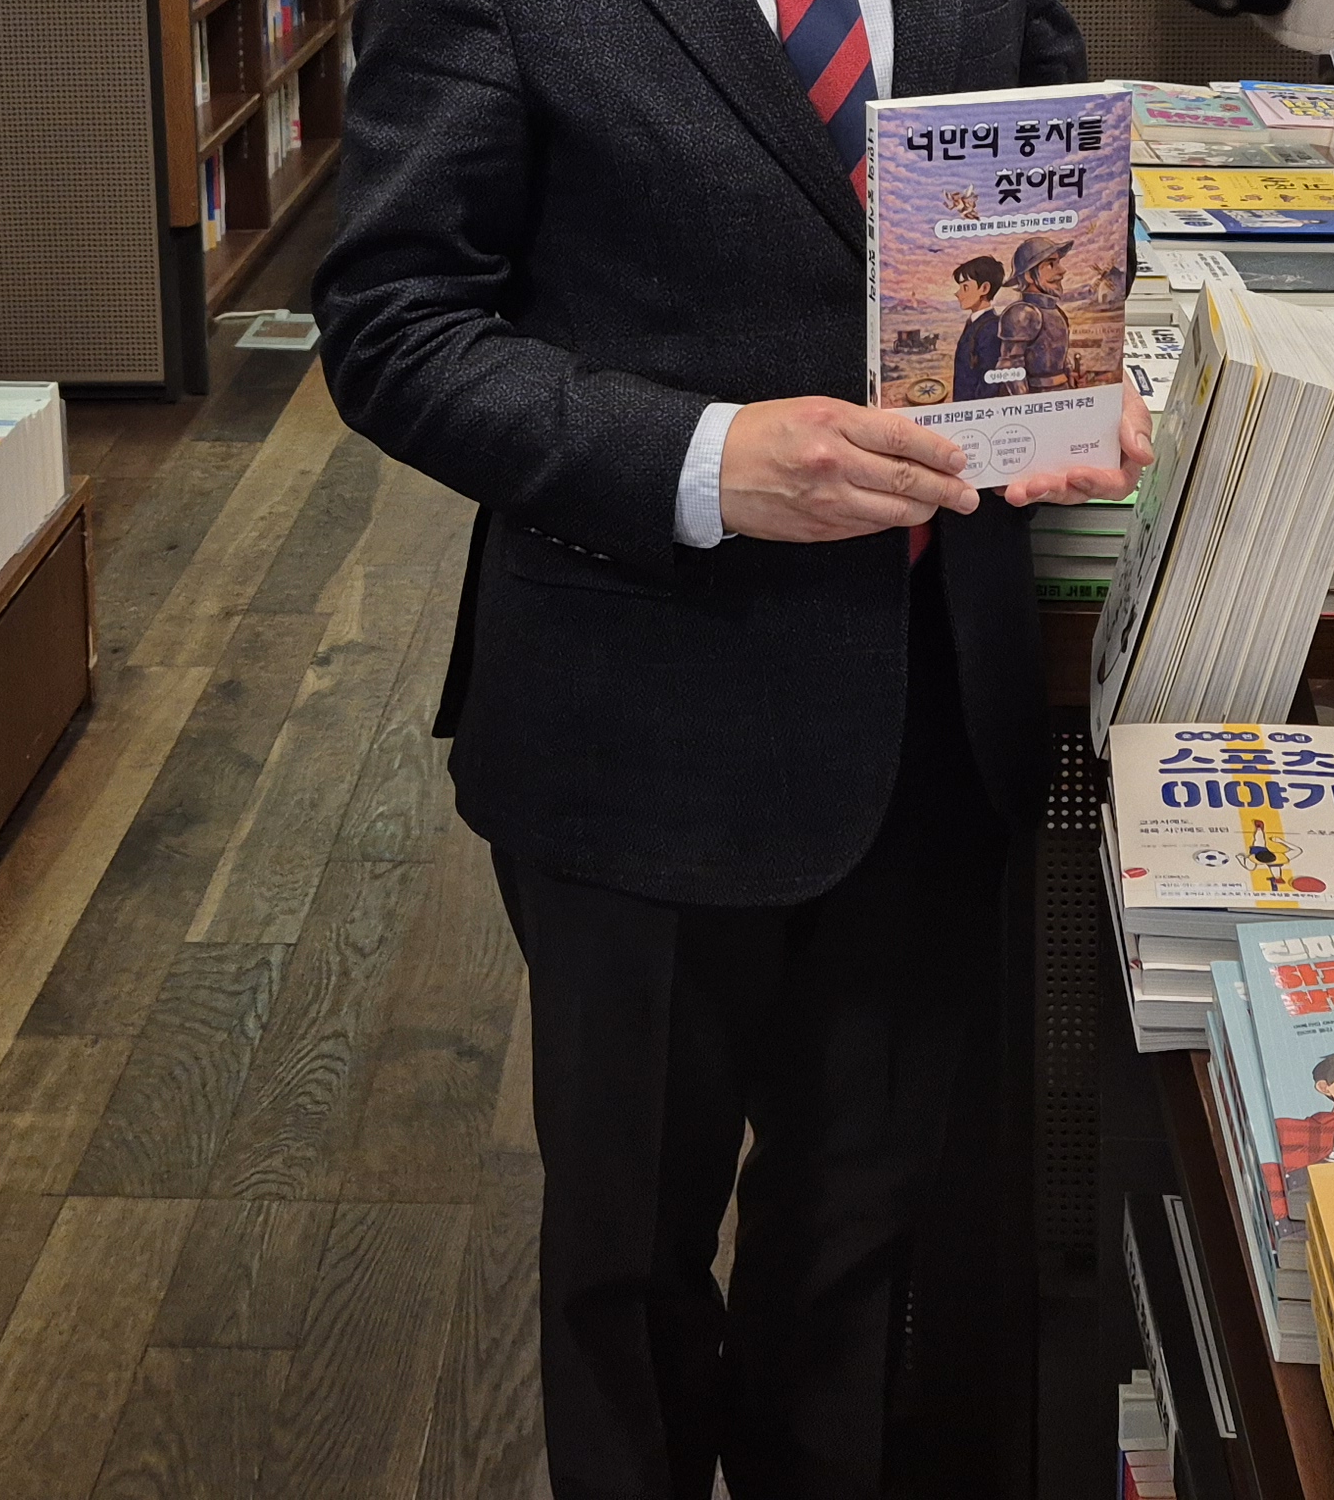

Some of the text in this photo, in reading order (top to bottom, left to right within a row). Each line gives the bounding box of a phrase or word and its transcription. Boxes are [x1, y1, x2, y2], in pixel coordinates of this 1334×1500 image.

[907, 115, 1104, 162] 너만의 풍차를
[995, 164, 1086, 205] 찾아라
[980, 222, 994, 230] 함께
[997, 220, 1018, 229] 떠나는
[1020, 218, 1040, 227] 5가지
[944, 397, 1095, 423] 최인철 교수 YTN 김대근 앵커 추천
